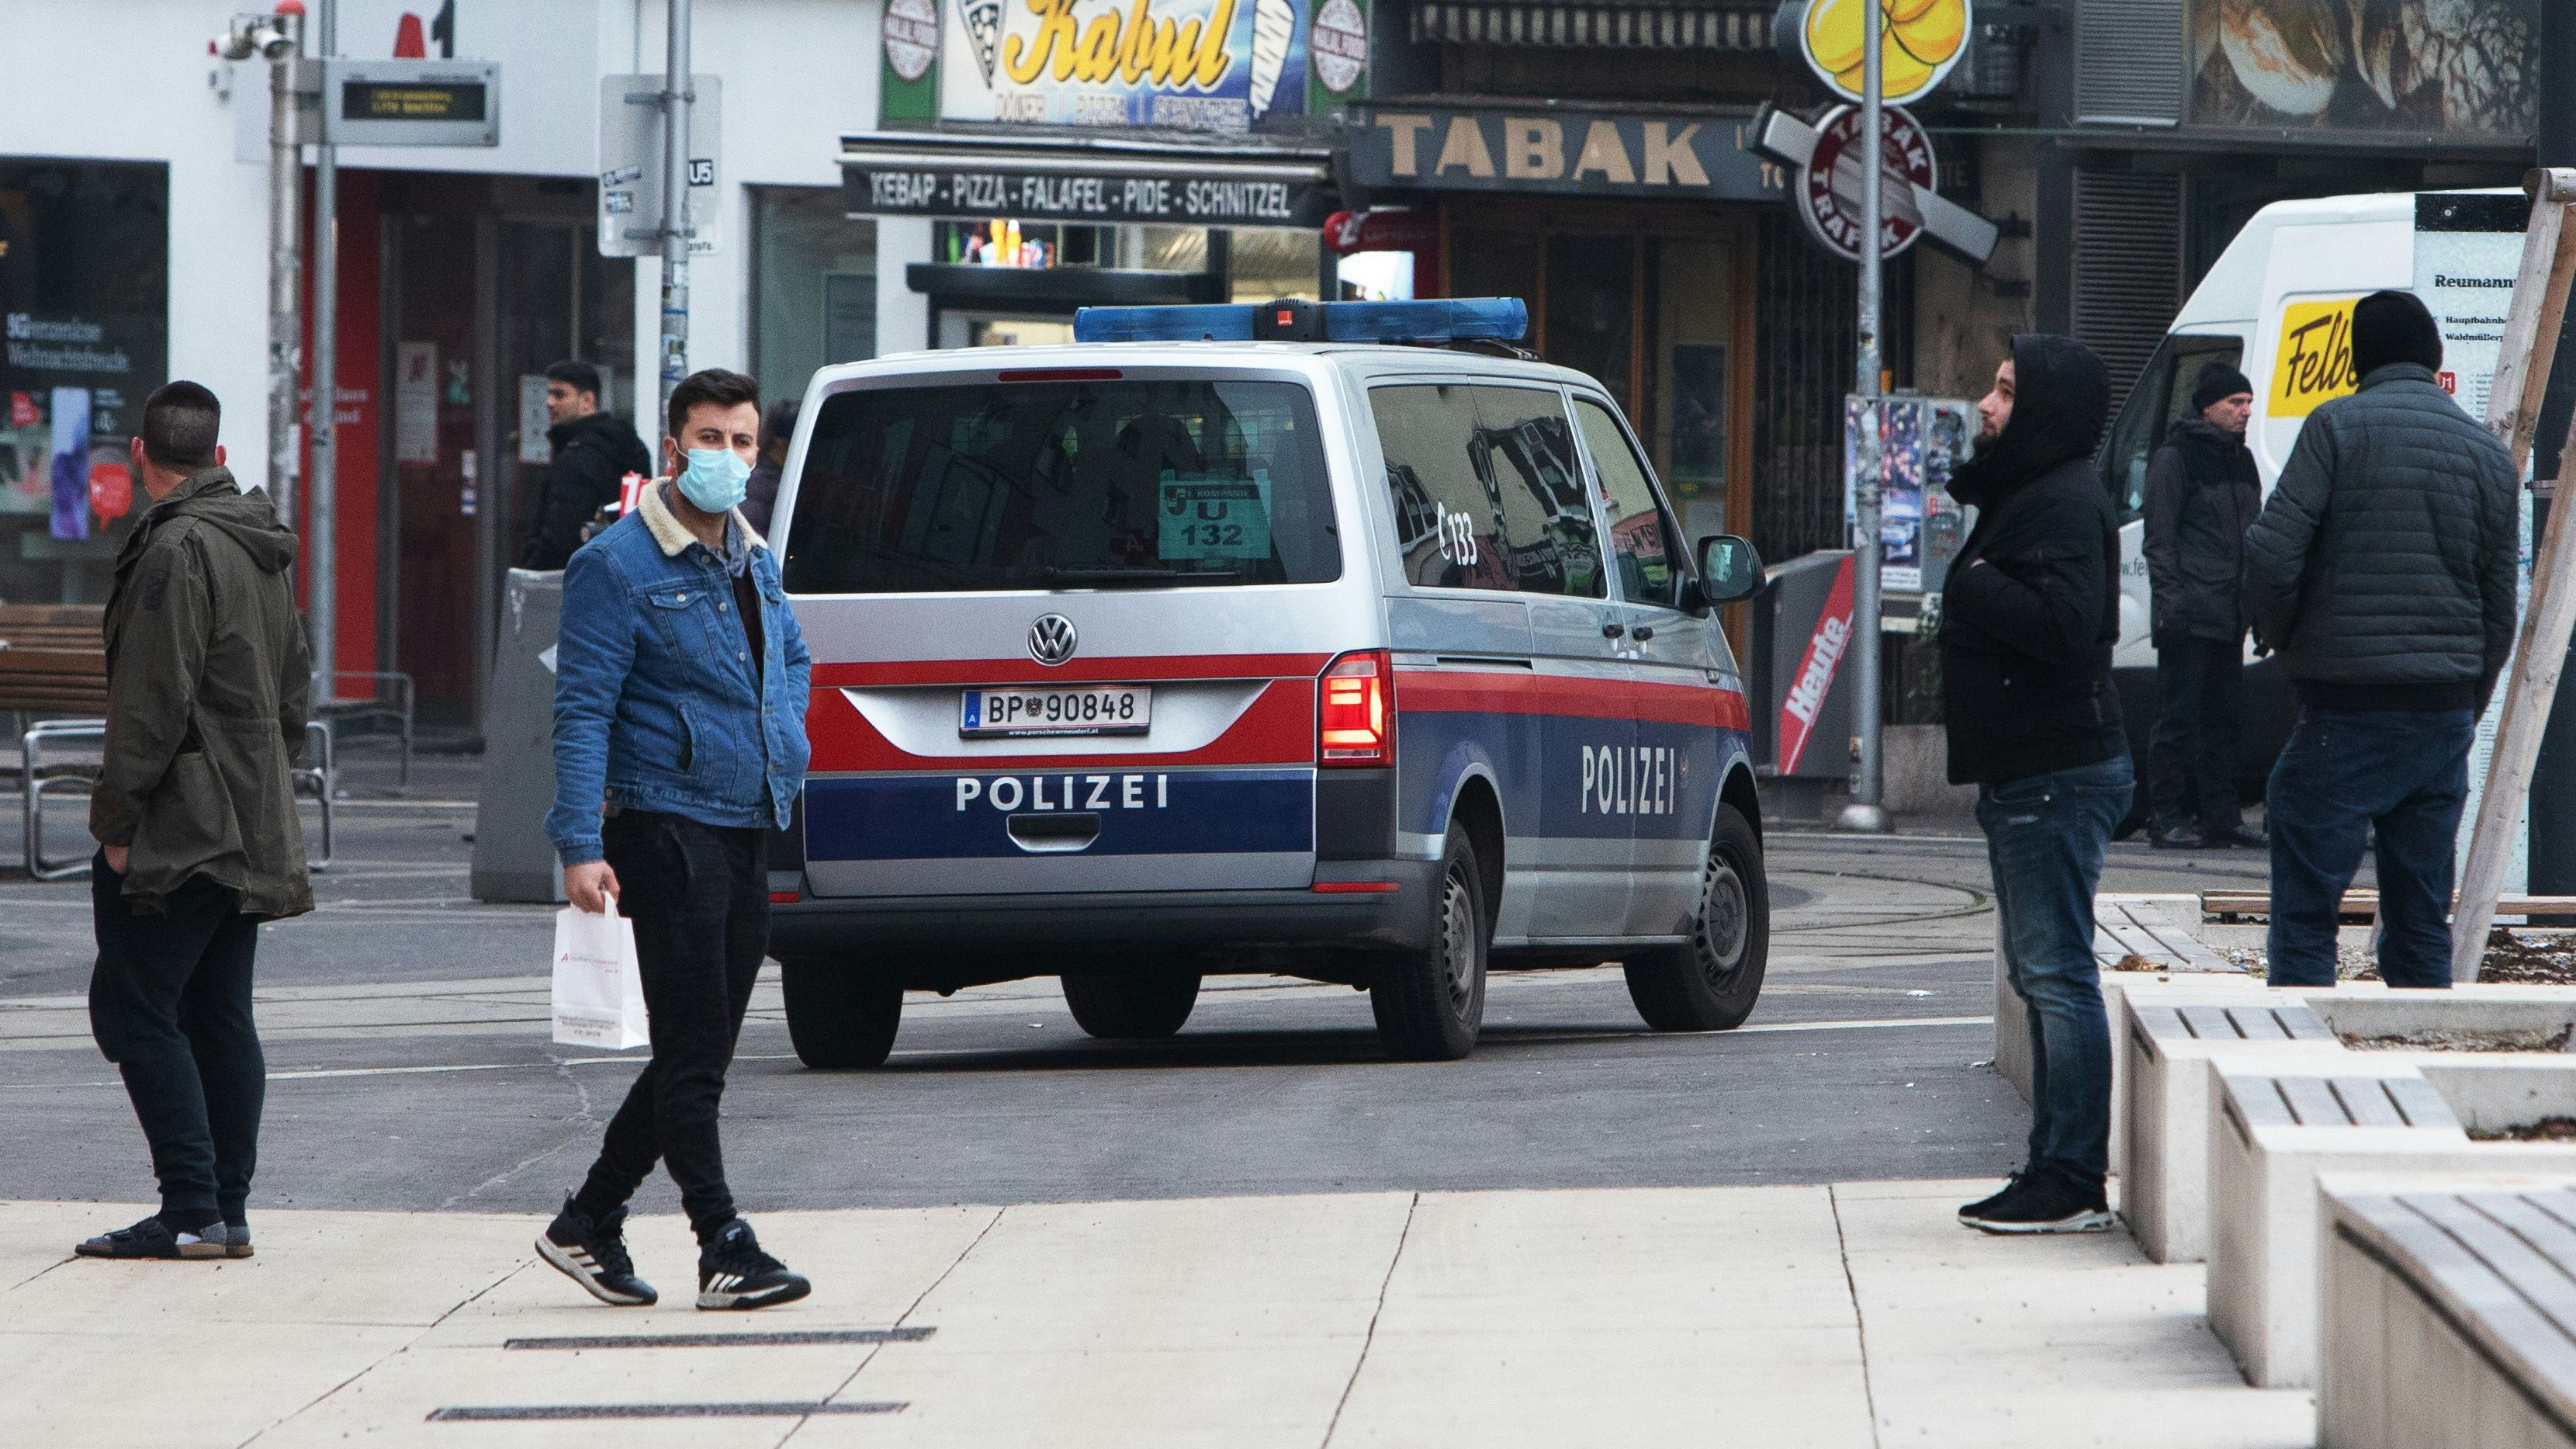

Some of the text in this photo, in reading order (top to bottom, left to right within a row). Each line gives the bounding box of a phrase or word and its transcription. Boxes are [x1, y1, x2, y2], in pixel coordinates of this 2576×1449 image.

[1003, 0, 1234, 87] Kabul
[1375, 114, 1710, 186] TABAK
[689, 161, 713, 185] U5
[871, 172, 1292, 218] KEBAP PIZZA FALAFEL PIDE SCHNITZEL
[2434, 274, 2518, 288] Reumann
[1181, 523, 1242, 546] 132
[1447, 512, 1477, 565] 133
[1785, 616, 1847, 723] Heute
[968, 714, 976, 723] A
[989, 693, 1134, 723] BP 90848
[956, 774, 1168, 812] POLIZEI
[1581, 745, 1674, 814] POLIZEI
